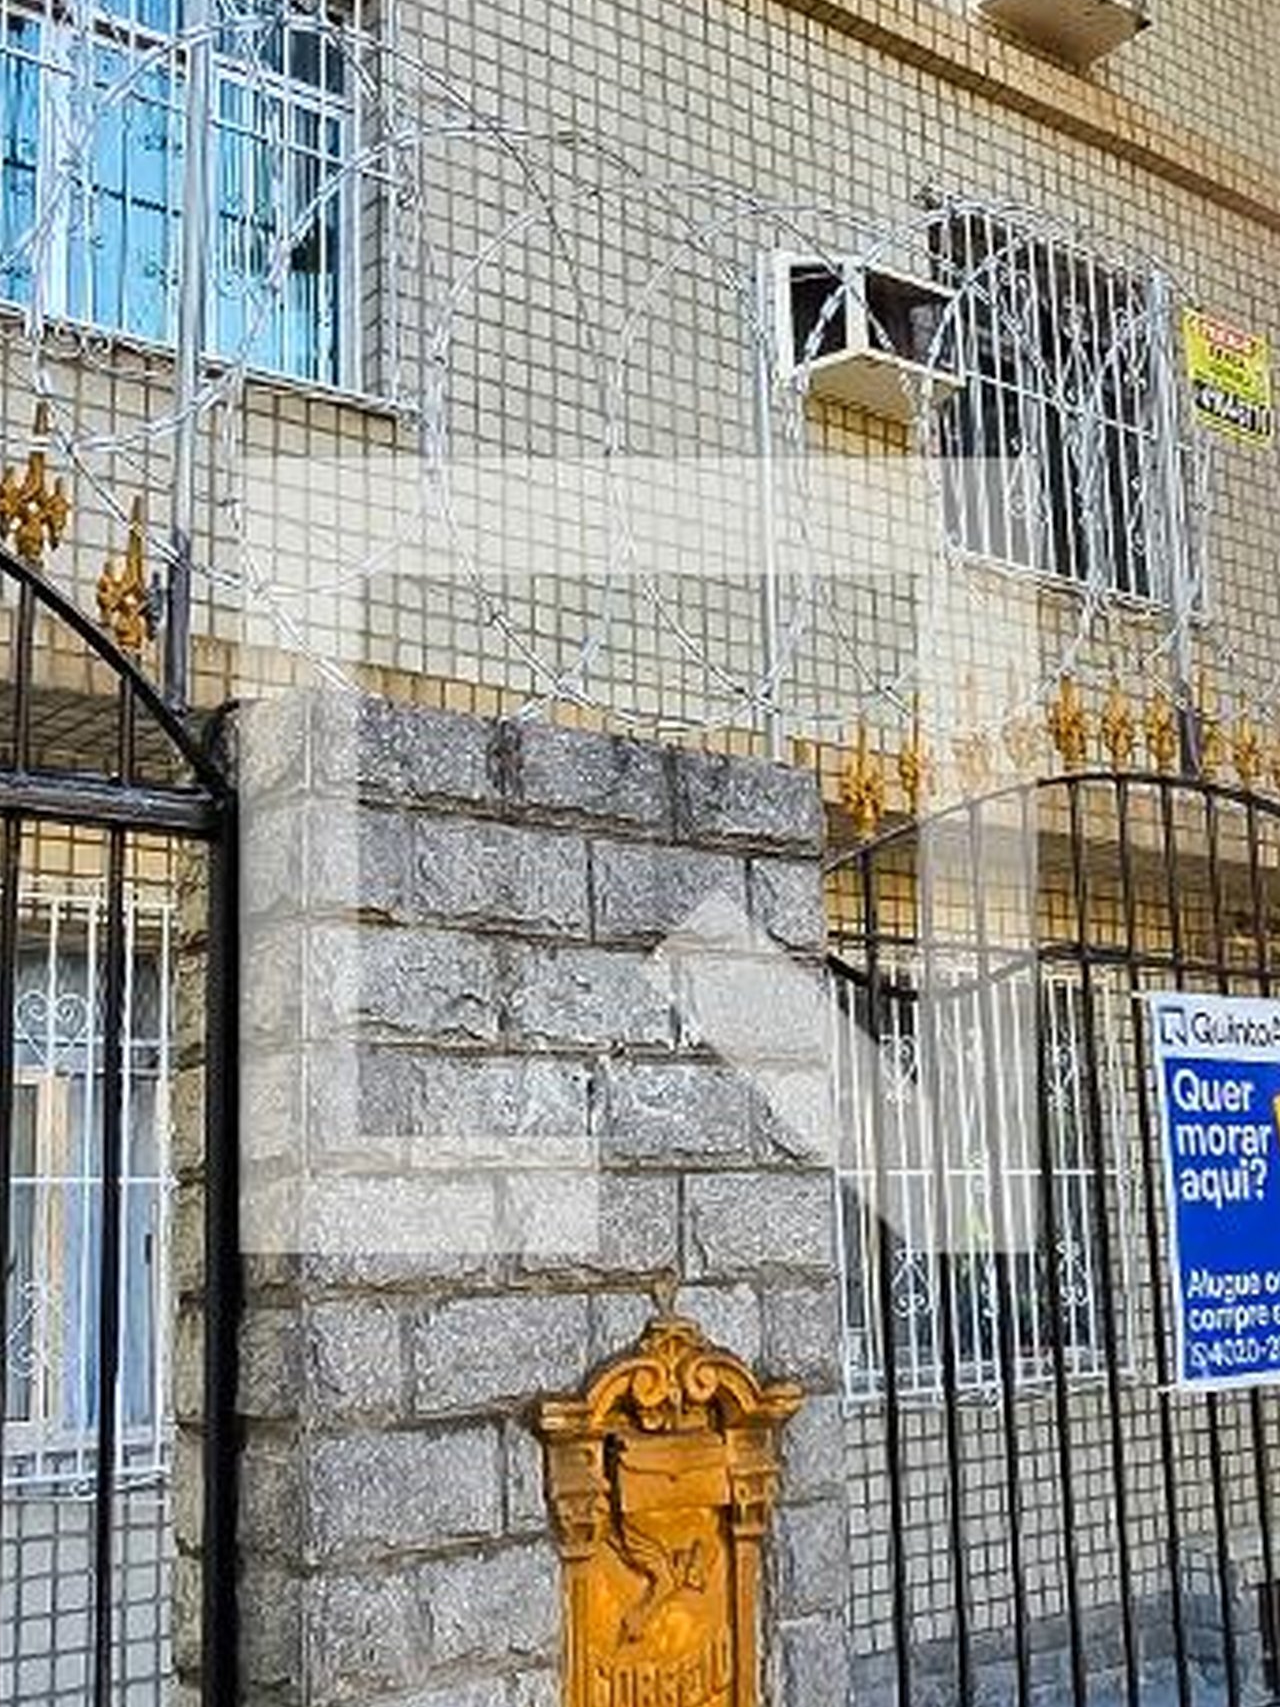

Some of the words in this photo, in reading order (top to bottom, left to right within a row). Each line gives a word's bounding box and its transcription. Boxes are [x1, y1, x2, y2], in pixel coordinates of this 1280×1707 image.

[1173, 1069, 1254, 1112] Quer
[1176, 1124, 1271, 1156] morar
[1180, 1158, 1267, 1210] aqui?
[1187, 1269, 1261, 1302] Alugue
[1189, 1305, 1269, 1335] compre
